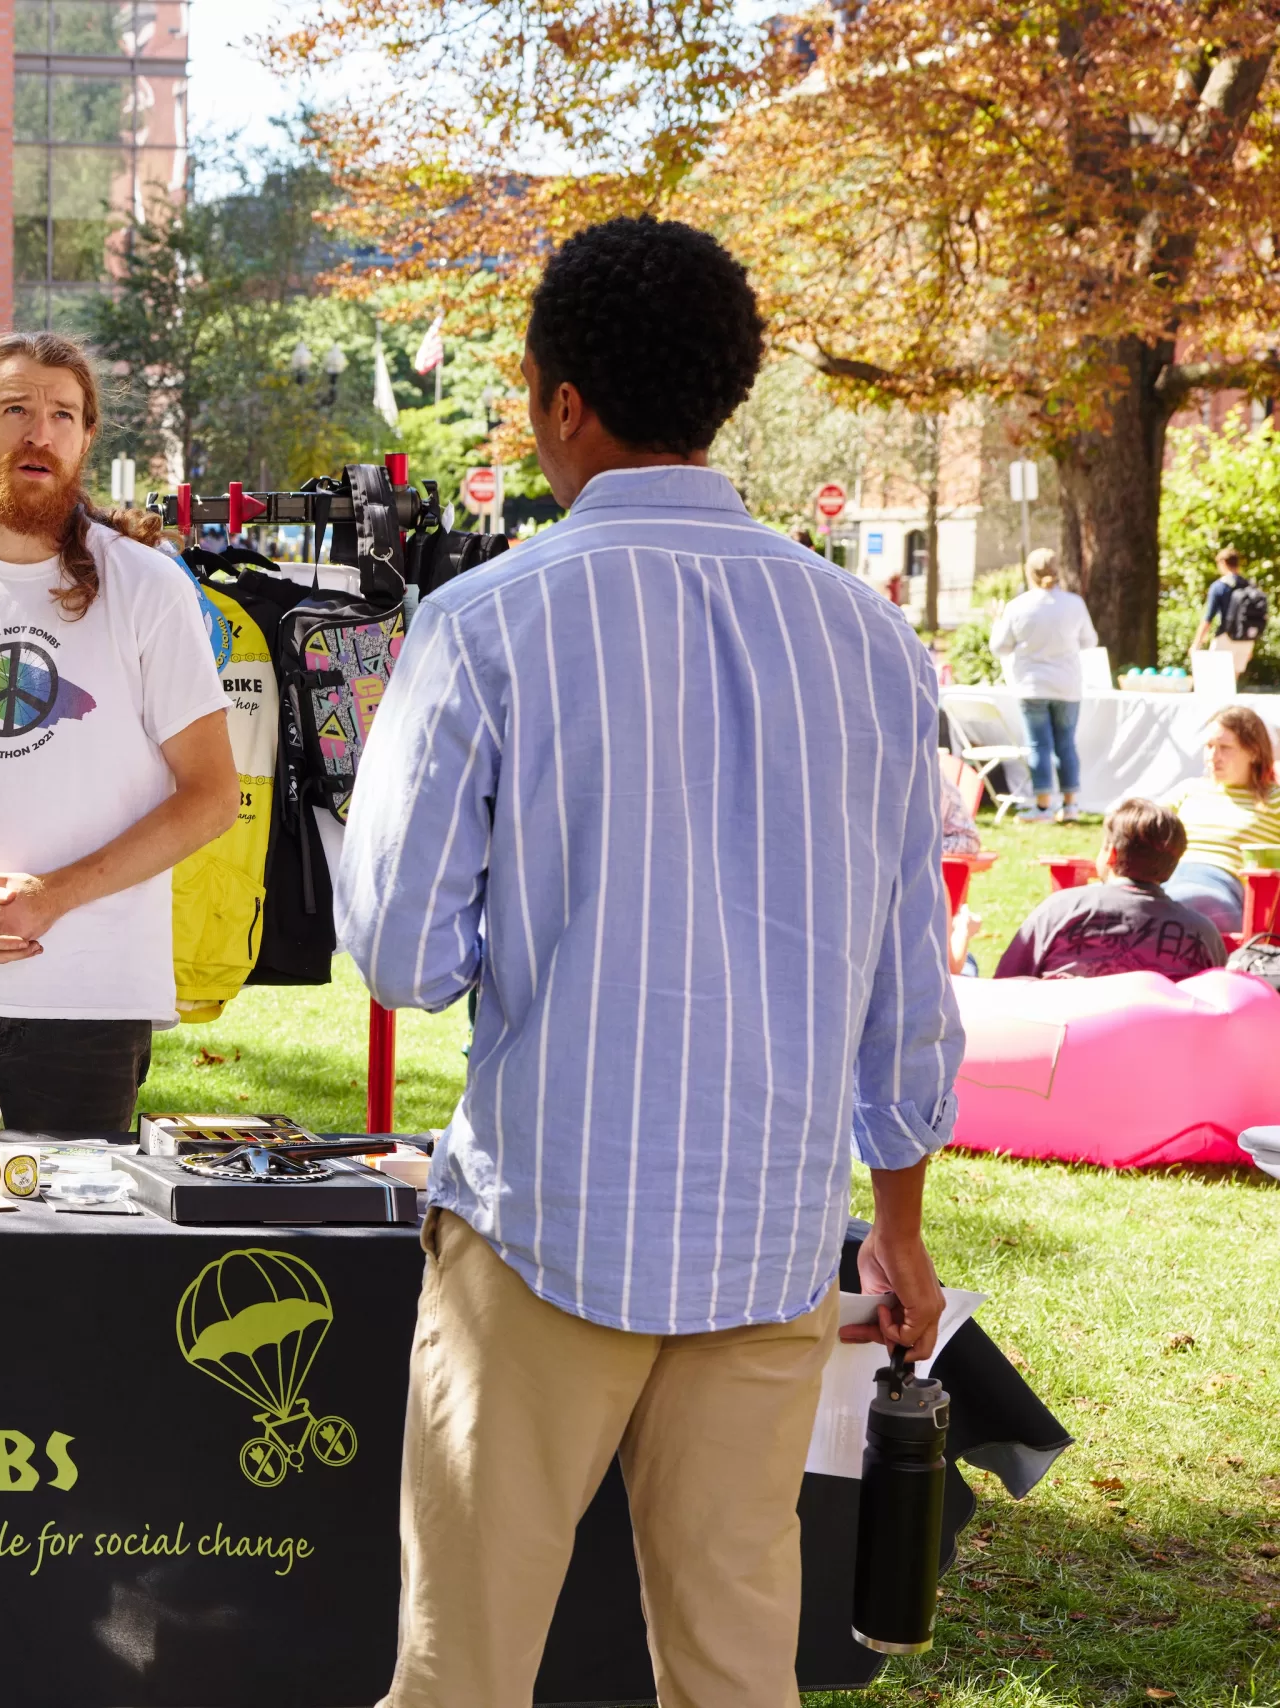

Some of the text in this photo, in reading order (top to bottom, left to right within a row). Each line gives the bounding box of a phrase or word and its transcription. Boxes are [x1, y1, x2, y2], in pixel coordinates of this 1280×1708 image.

[3, 626, 27, 636] NOT
[28, 626, 61, 649] BOMBS
[223, 678, 263, 693] BIKE
[232, 697, 260, 716] hop
[31, 730, 55, 751] 2021
[29, 1520, 83, 1576] for
[93, 1521, 191, 1557] social
[197, 1521, 315, 1576] change
